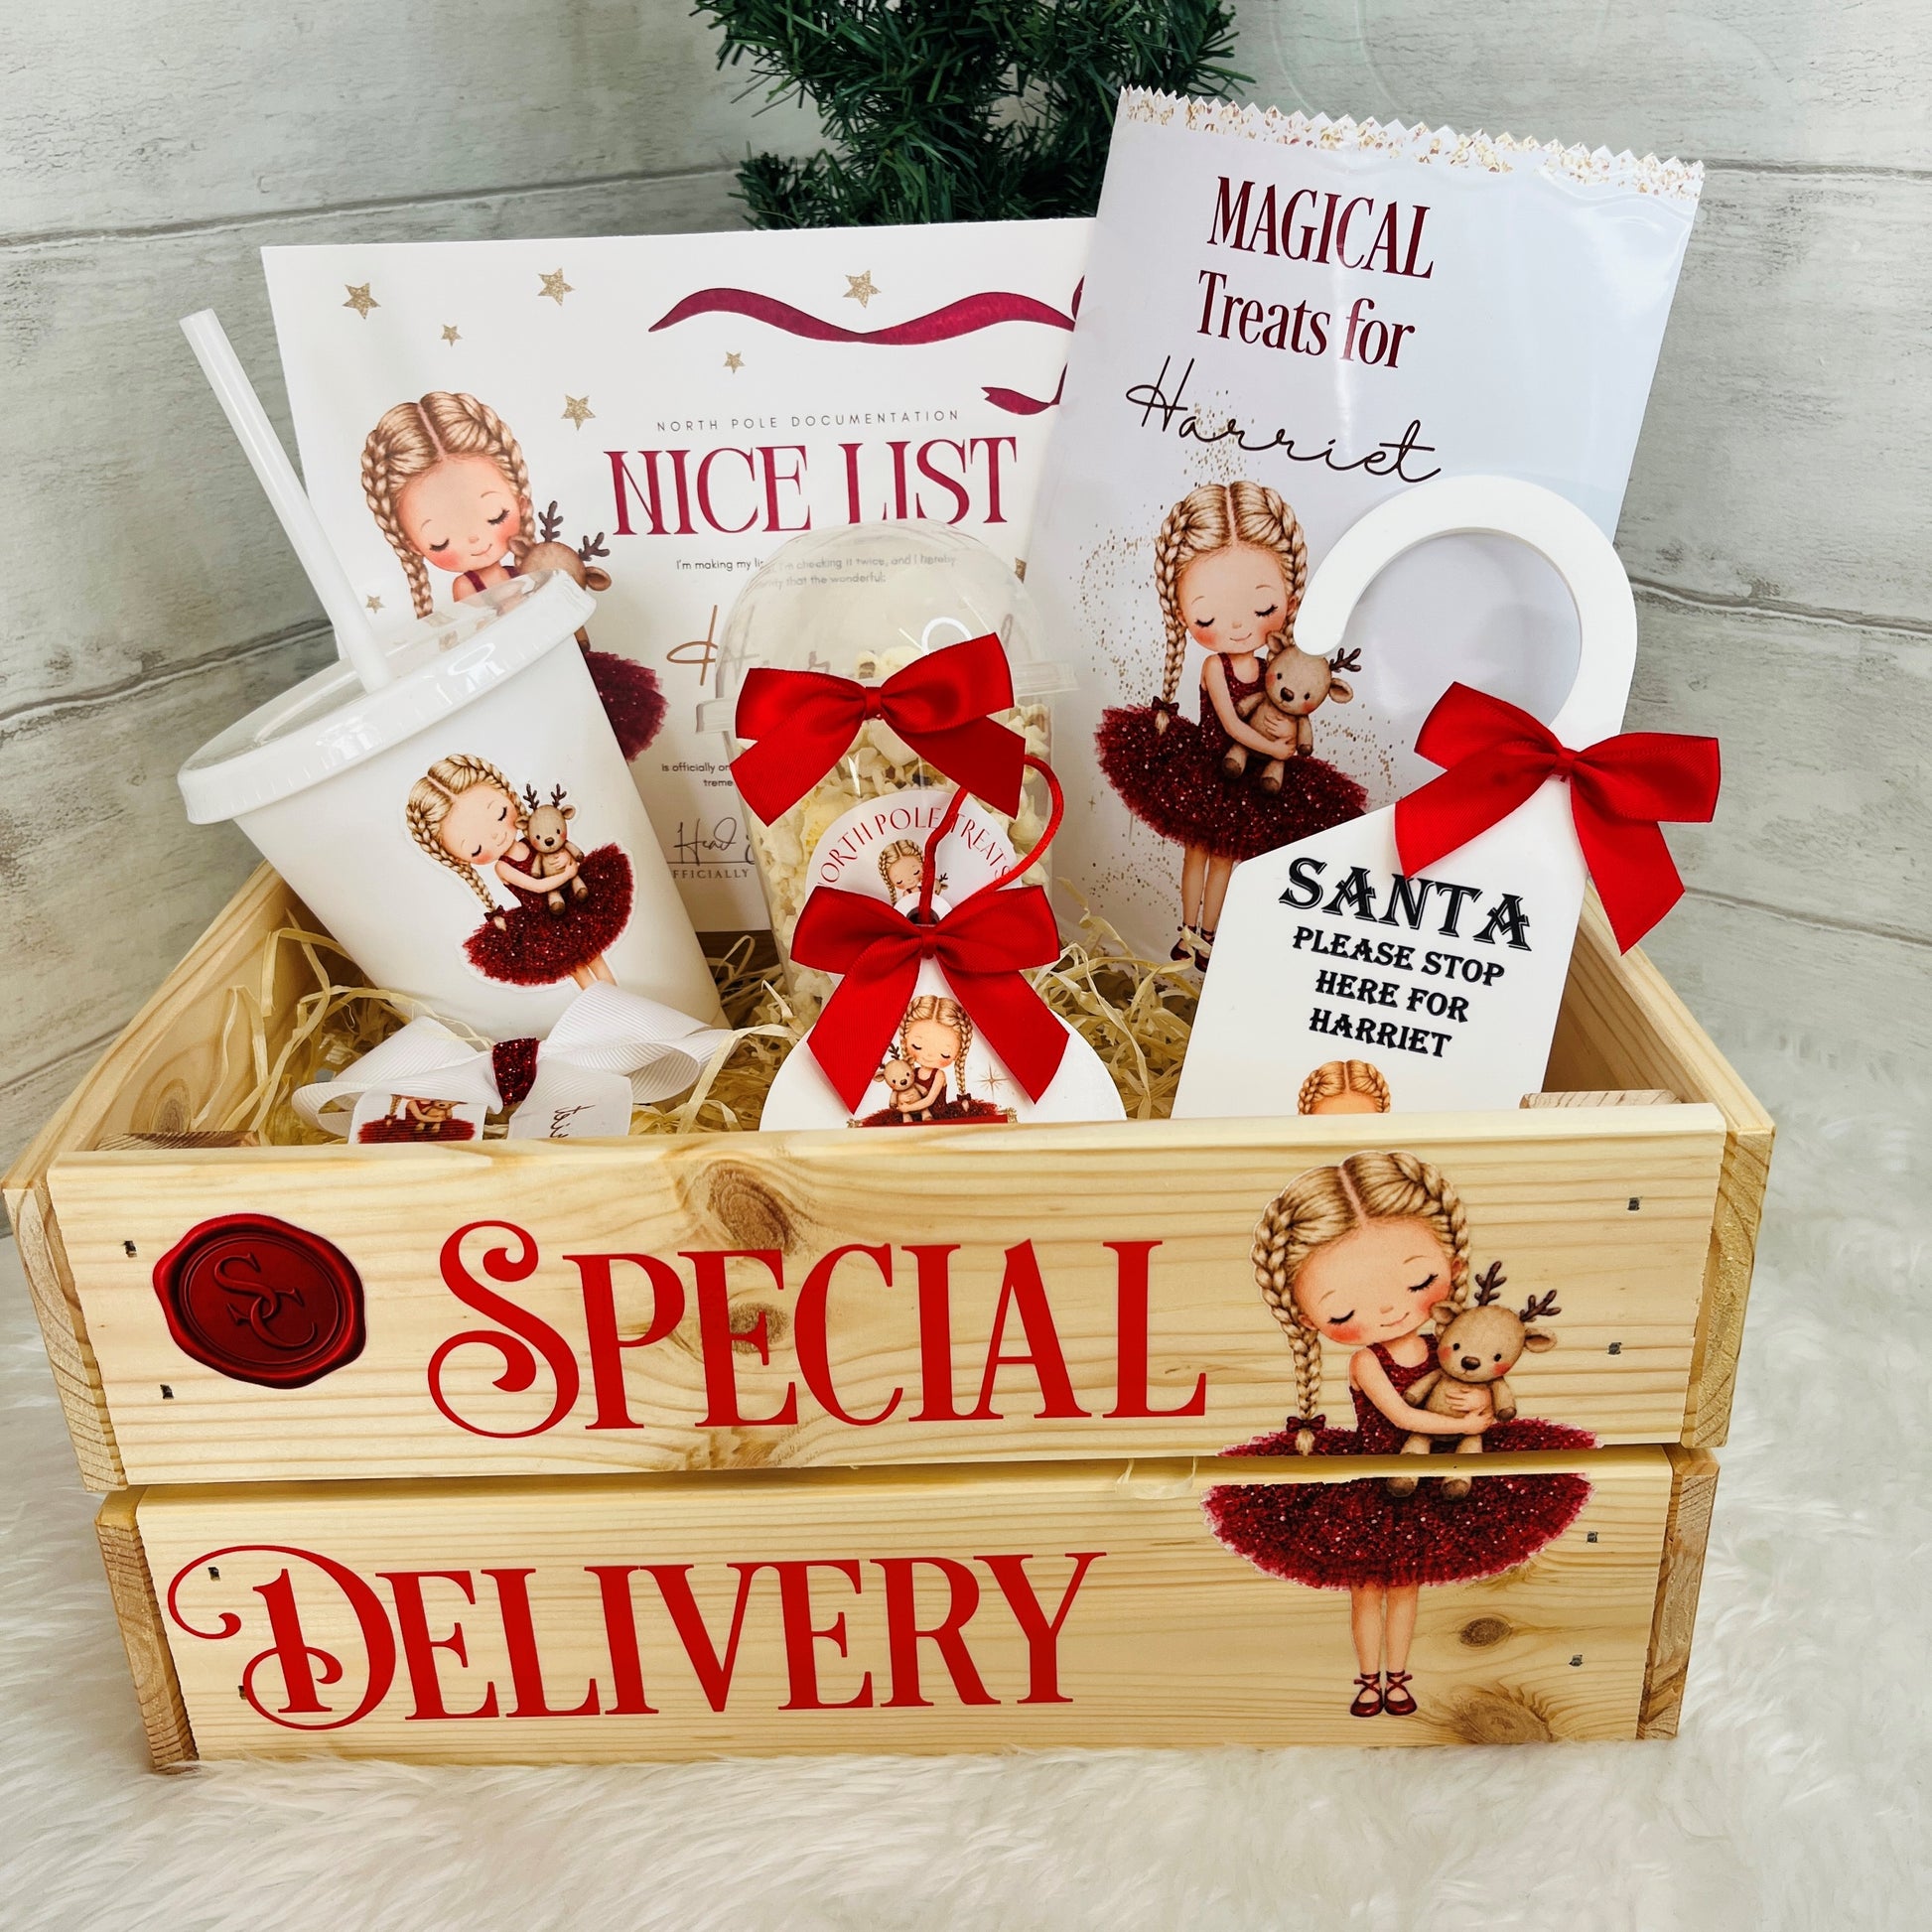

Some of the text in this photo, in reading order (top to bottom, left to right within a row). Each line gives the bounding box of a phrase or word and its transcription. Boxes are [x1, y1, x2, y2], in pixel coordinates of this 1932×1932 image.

[1206, 176, 1434, 279] MAGICAL
[1196, 269, 1416, 368] Treats for
[657, 410, 959, 432] NORTH POLE DOCUMENTATION
[1126, 355, 1442, 483] Harriet
[603, 436, 1018, 536] NICE LIST
[675, 559, 692, 570] I'm
[695, 558, 734, 572] making
[737, 559, 752, 570] my
[796, 556, 842, 570] checking
[891, 554, 911, 565] and
[810, 574, 828, 584] the
[672, 761, 716, 774] officially
[673, 868, 750, 880] FFICIALLY
[818, 822, 874, 887] ORTH
[875, 806, 942, 835] POLE
[950, 812, 1011, 880] TREATS
[1278, 857, 1532, 951] SANTA
[1292, 925, 1505, 987] PLEASE STOP
[1309, 1007, 1452, 1057] HARRIET
[1314, 969, 1469, 1024] HERE FOR
[427, 1220, 1207, 1439] SPECIAL
[167, 1544, 1108, 1731] DELIVERY
